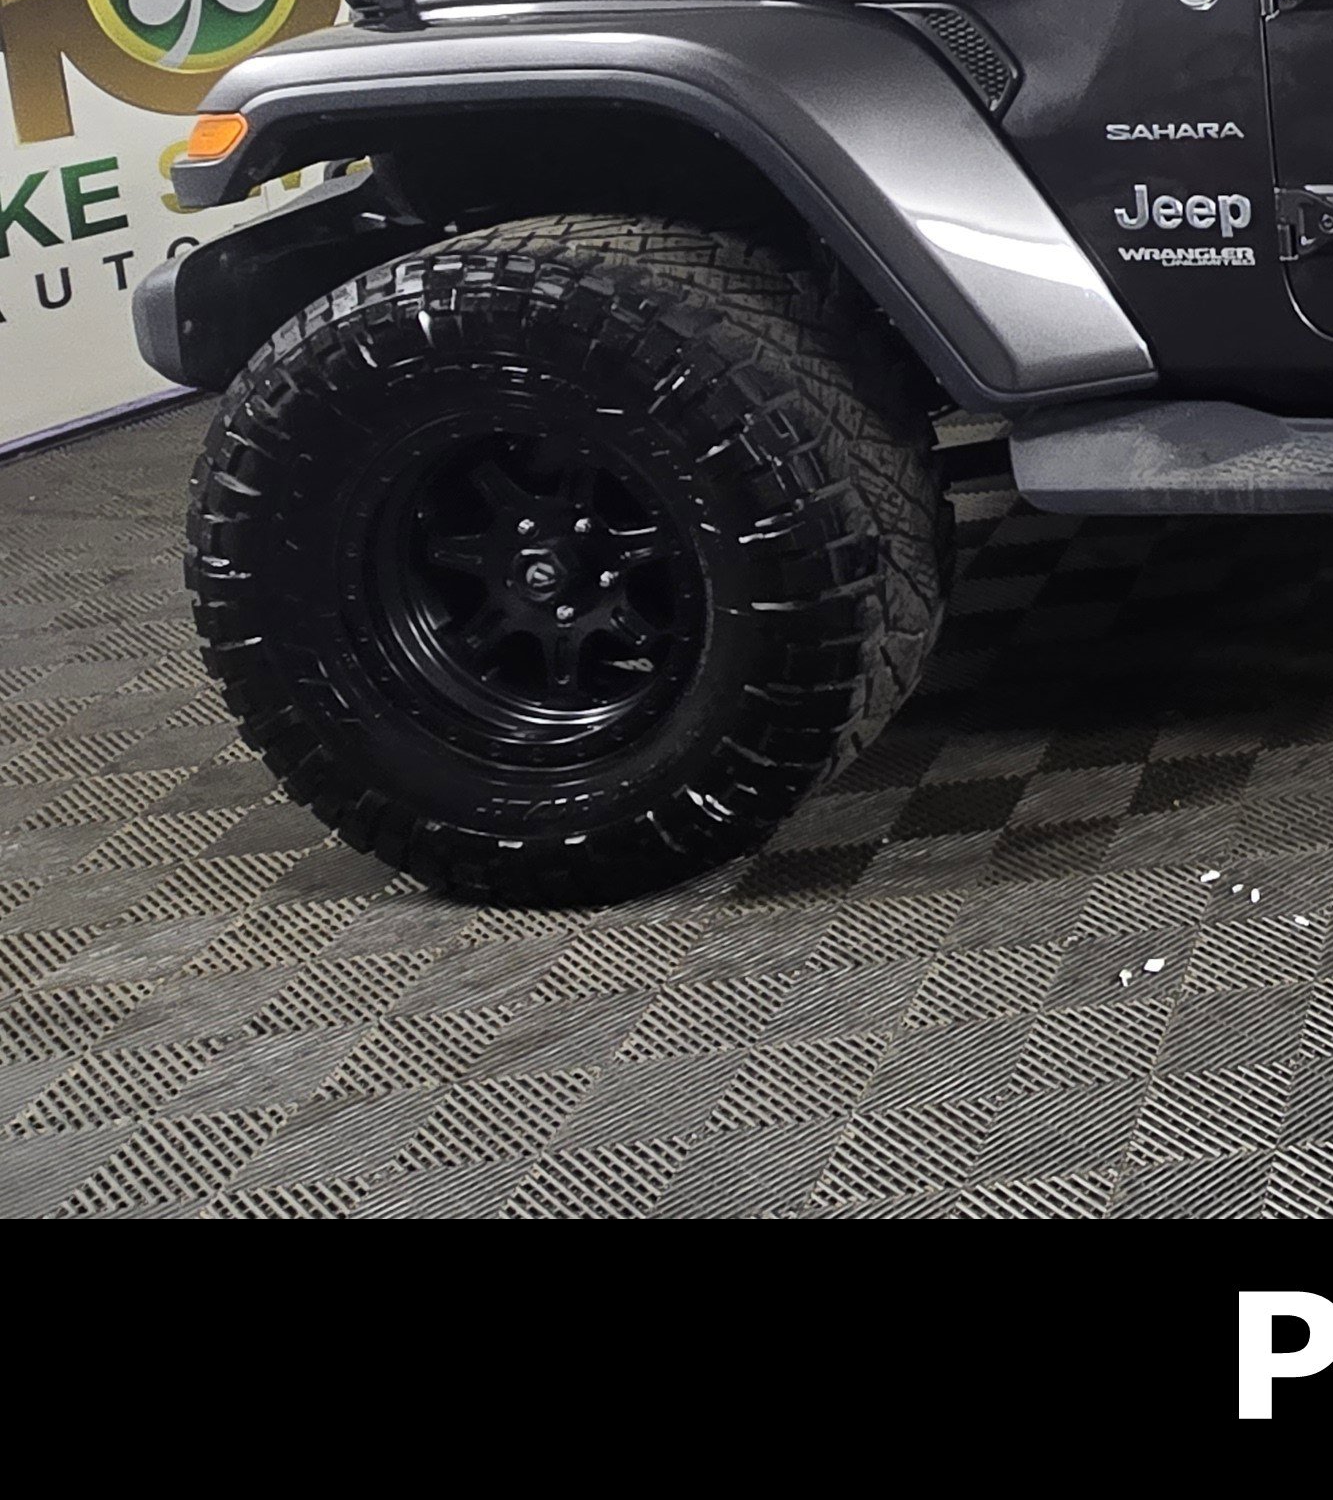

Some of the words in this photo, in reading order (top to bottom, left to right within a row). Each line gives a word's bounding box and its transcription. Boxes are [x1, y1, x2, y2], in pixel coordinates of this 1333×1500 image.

[1106, 121, 1245, 141] SAHARA
[0, 156, 129, 260] KE
[1114, 184, 1252, 238] Jeep
[1117, 246, 1255, 261] WRANGLER
